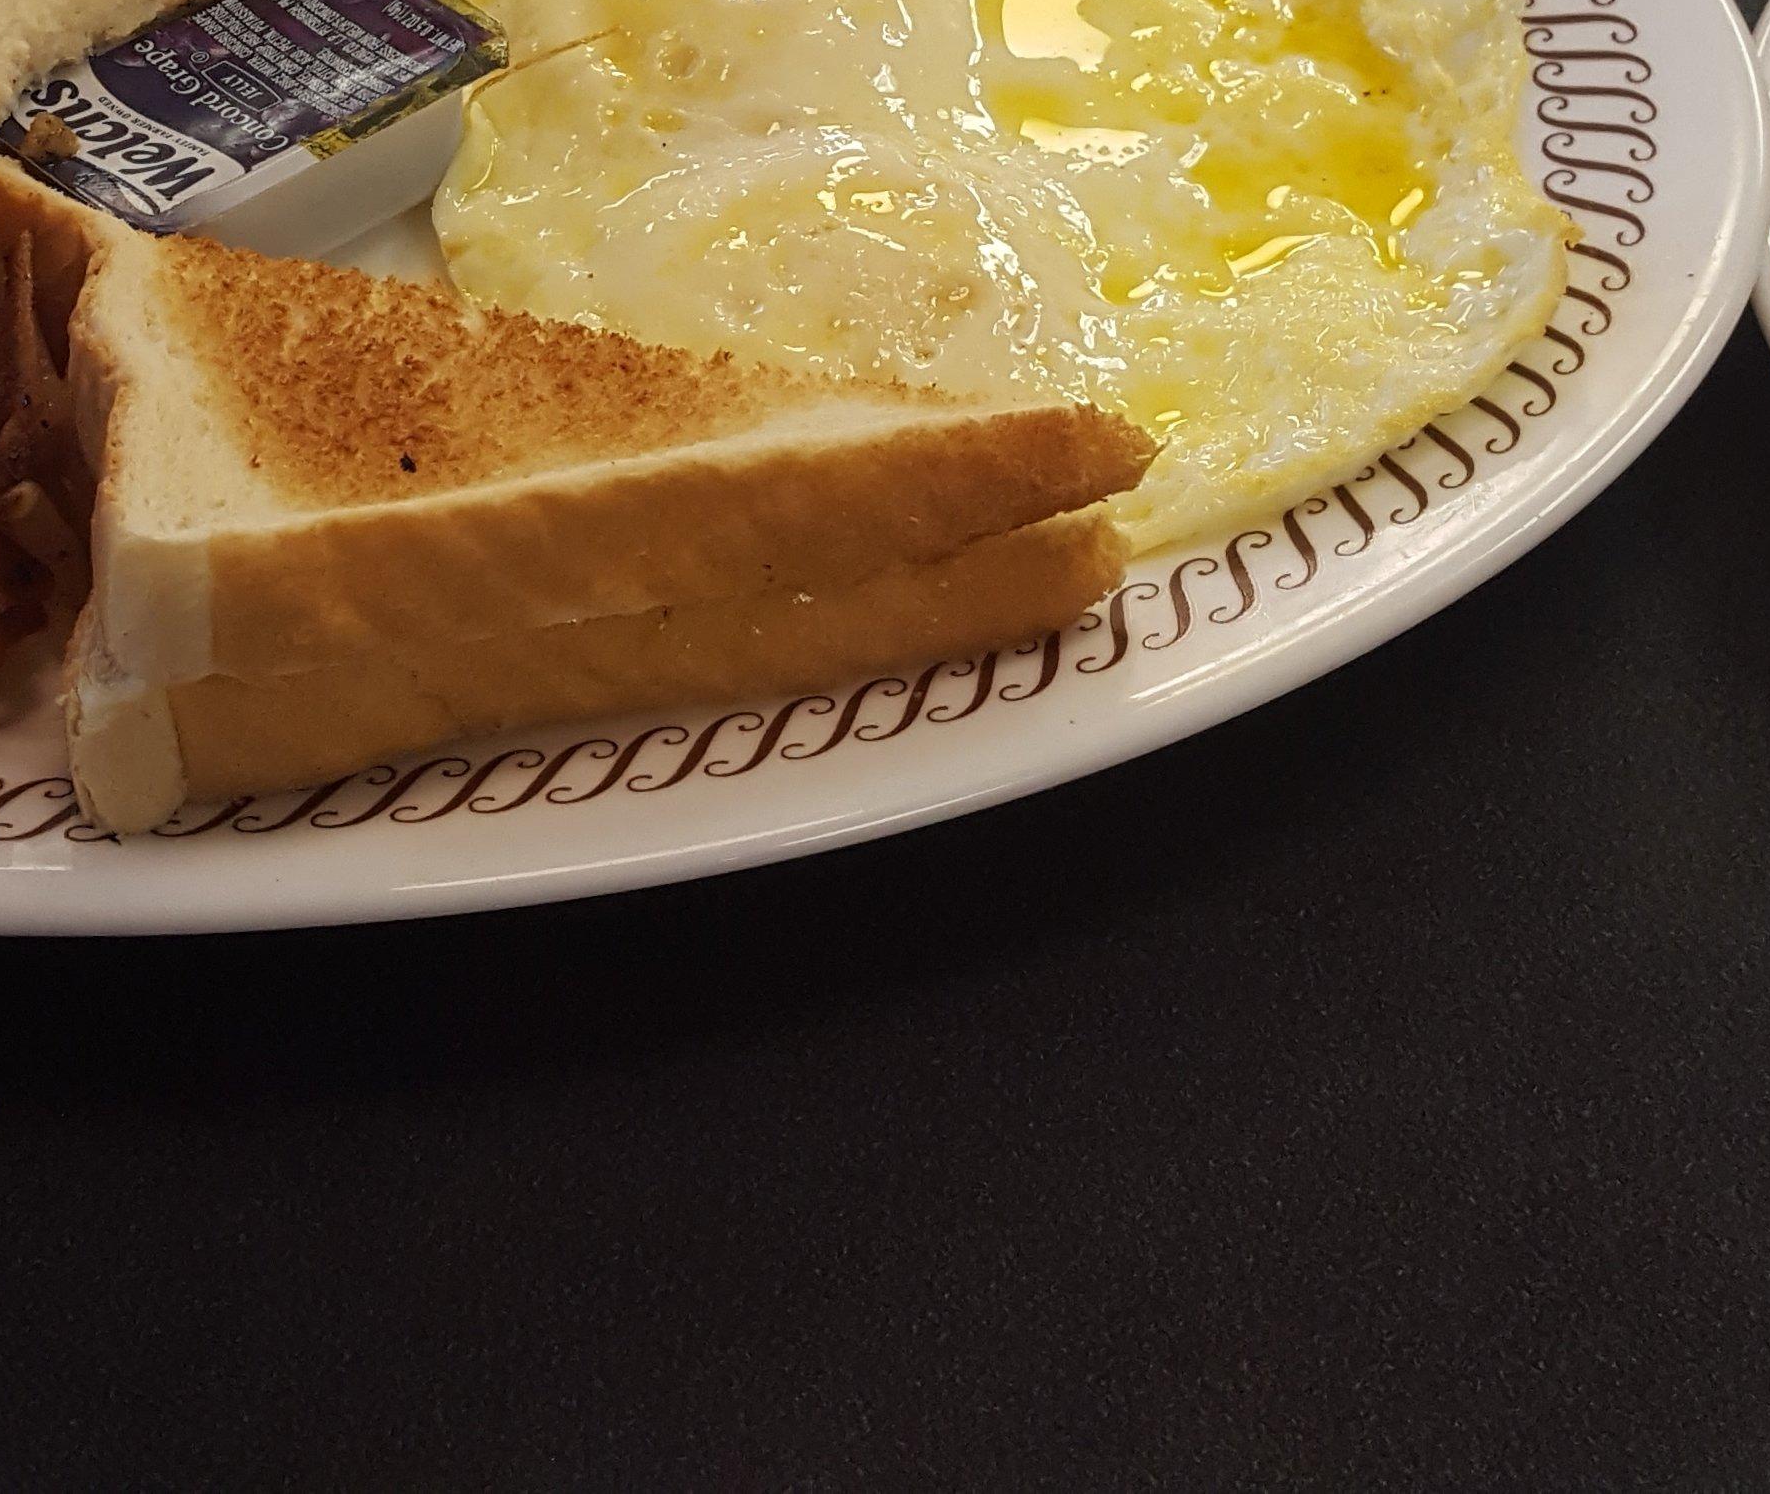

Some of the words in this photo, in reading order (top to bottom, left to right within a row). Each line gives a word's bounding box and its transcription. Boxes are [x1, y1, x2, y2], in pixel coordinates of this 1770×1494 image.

[190, 10, 224, 35] GRAPE
[204, 2, 250, 35] FRUCTOSE
[134, 39, 202, 95] Grape
[218, 72, 264, 100] JELLY
[95, 95, 133, 119] OWNED
[129, 116, 174, 139] FARMER
[189, 90, 289, 153] Concord
[172, 136, 211, 156] FAMILY
